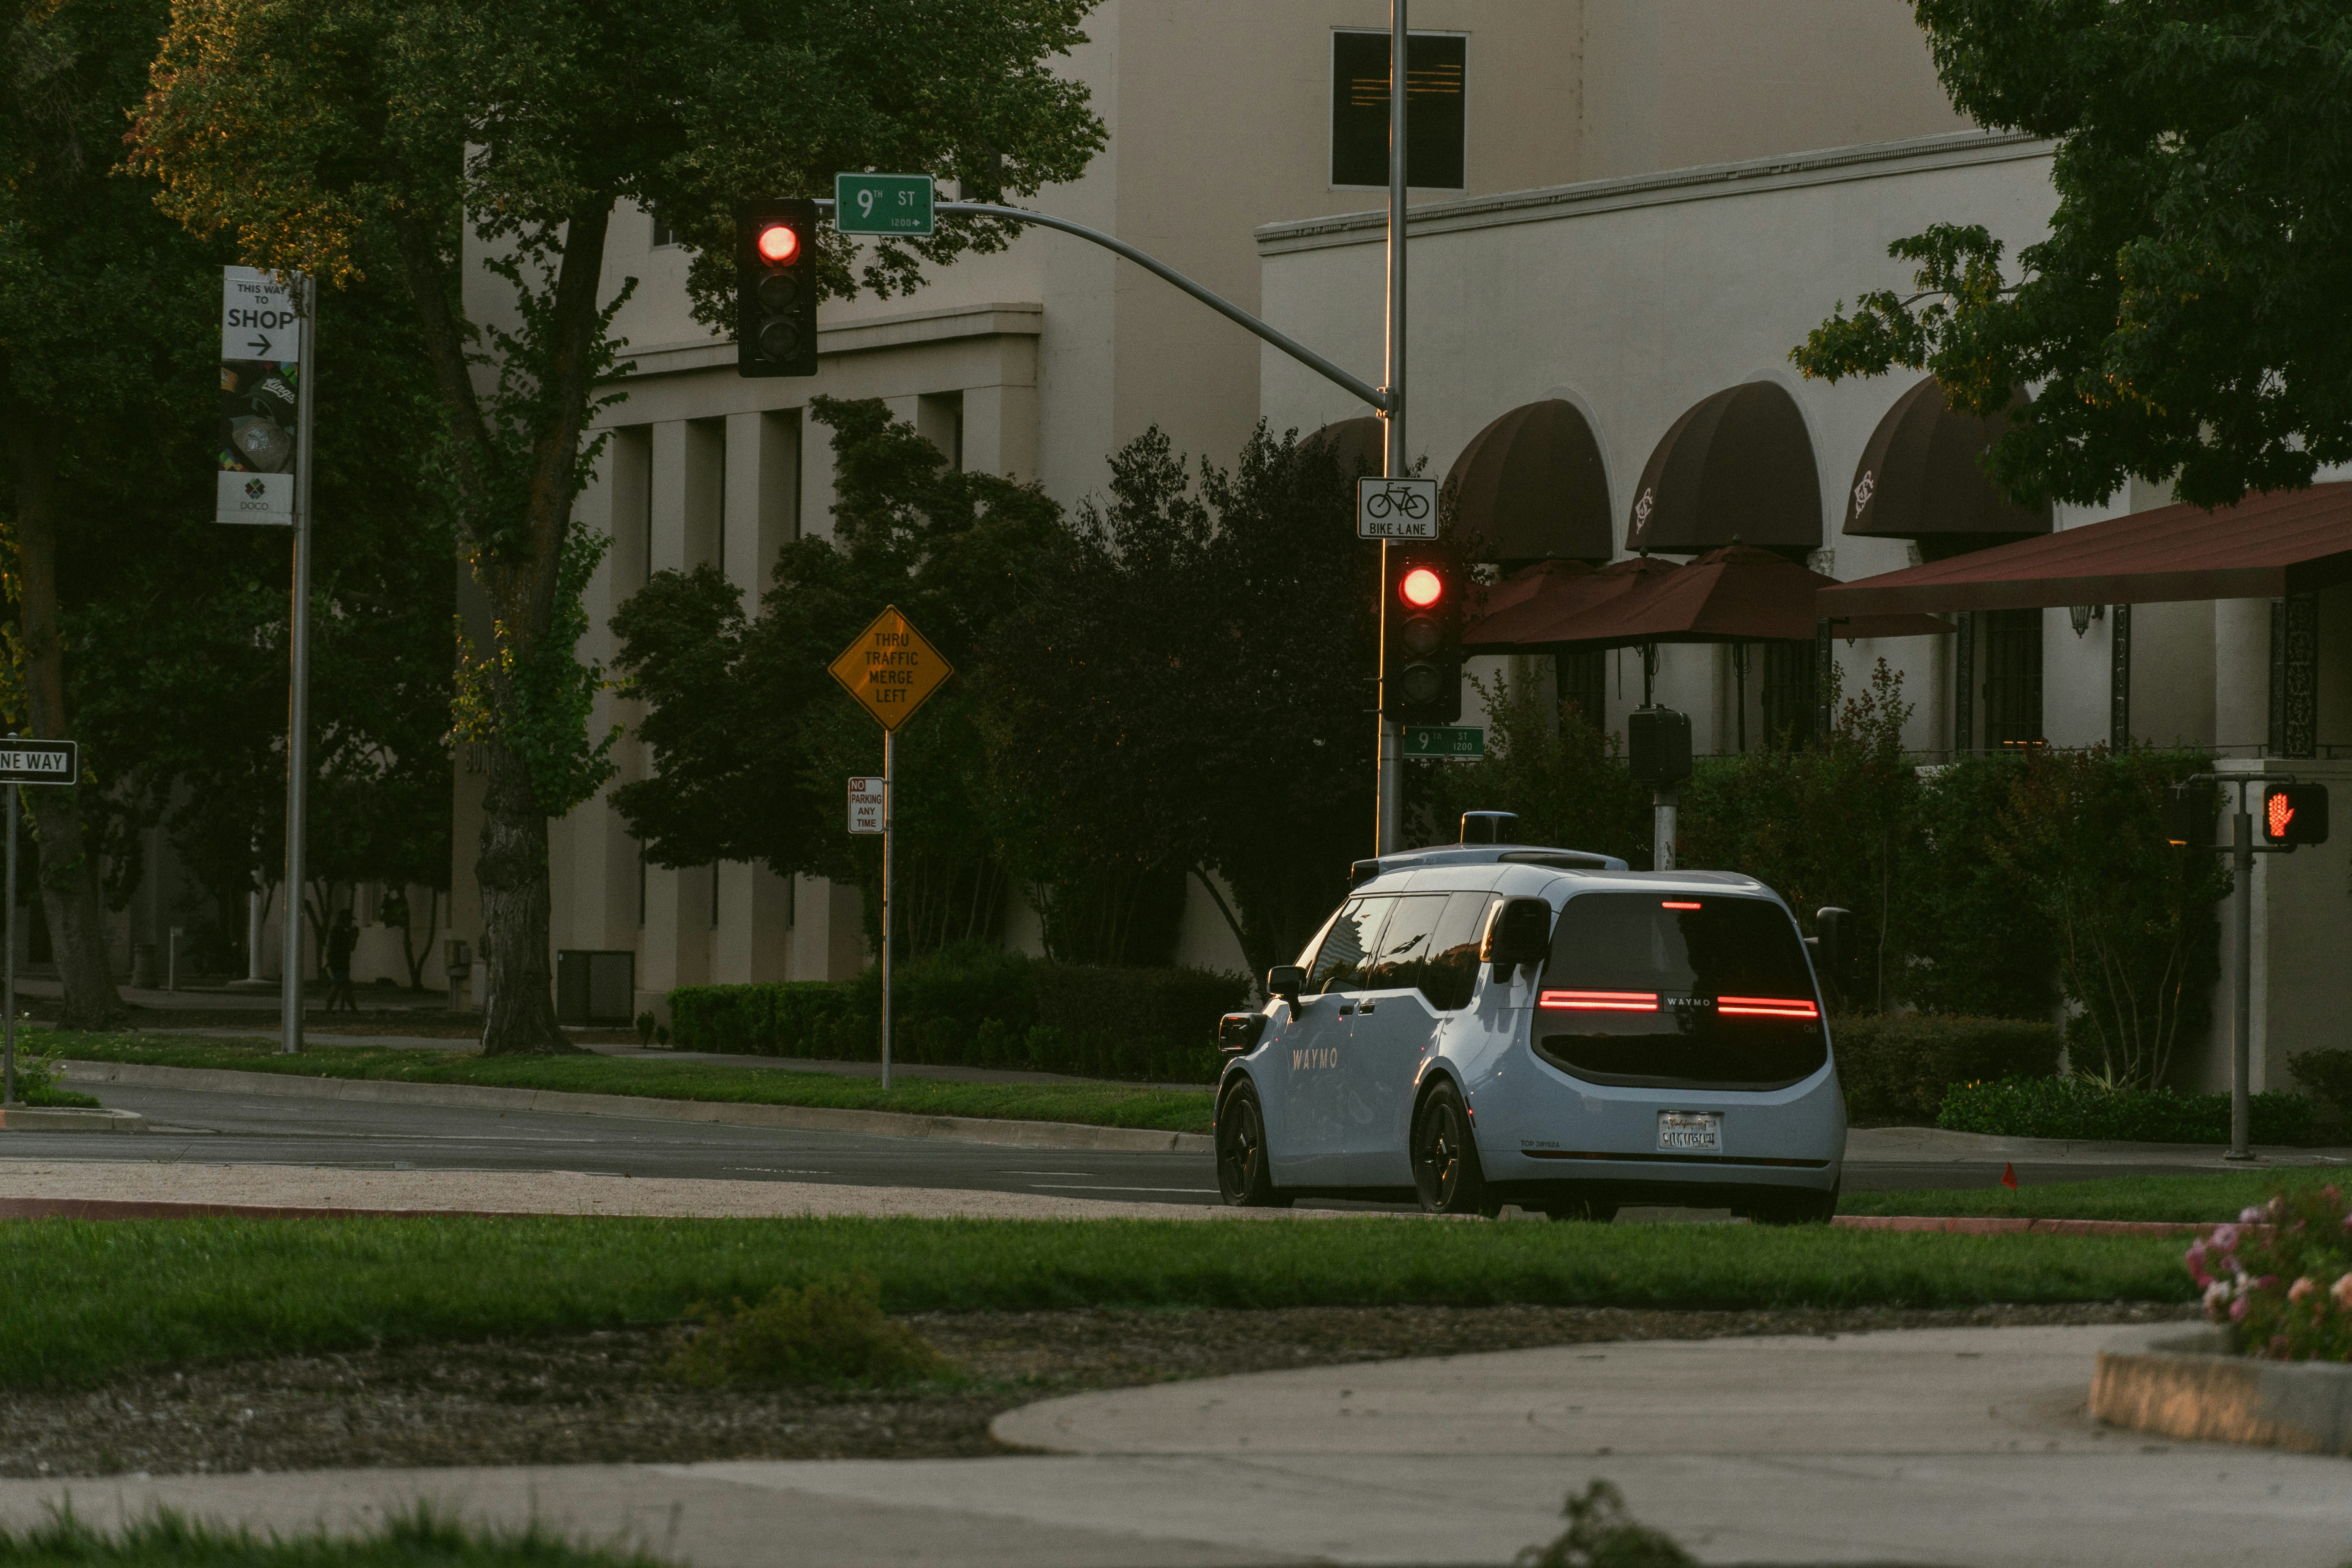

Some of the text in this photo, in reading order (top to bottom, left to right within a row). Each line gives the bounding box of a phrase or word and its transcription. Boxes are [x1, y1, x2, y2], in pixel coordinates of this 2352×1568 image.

[898, 190, 915, 206] ST
[891, 218, 911, 227] 1200
[237, 284, 286, 294] THIS WAY
[254, 295, 269, 304] TO
[228, 308, 294, 330] SHOP
[261, 378, 296, 405] Kings
[240, 501, 269, 511] DOCO
[1369, 523, 1426, 535] BIKE LANE
[874, 632, 909, 647] THRU
[865, 651, 918, 665] TRAFFIC
[869, 670, 914, 684] MERGE
[876, 689, 907, 703] LEFT
[1458, 732, 1468, 740] ST
[1453, 742, 1472, 751] 1200
[0, 753, 63, 770] NE WAY
[851, 780, 865, 790] NO
[852, 794, 882, 804] PARKING
[858, 807, 876, 815] ANY
[857, 819, 876, 827] TIME
[1667, 998, 1710, 1007] WAYMO
[1293, 1047, 1337, 1070] WAYMO
